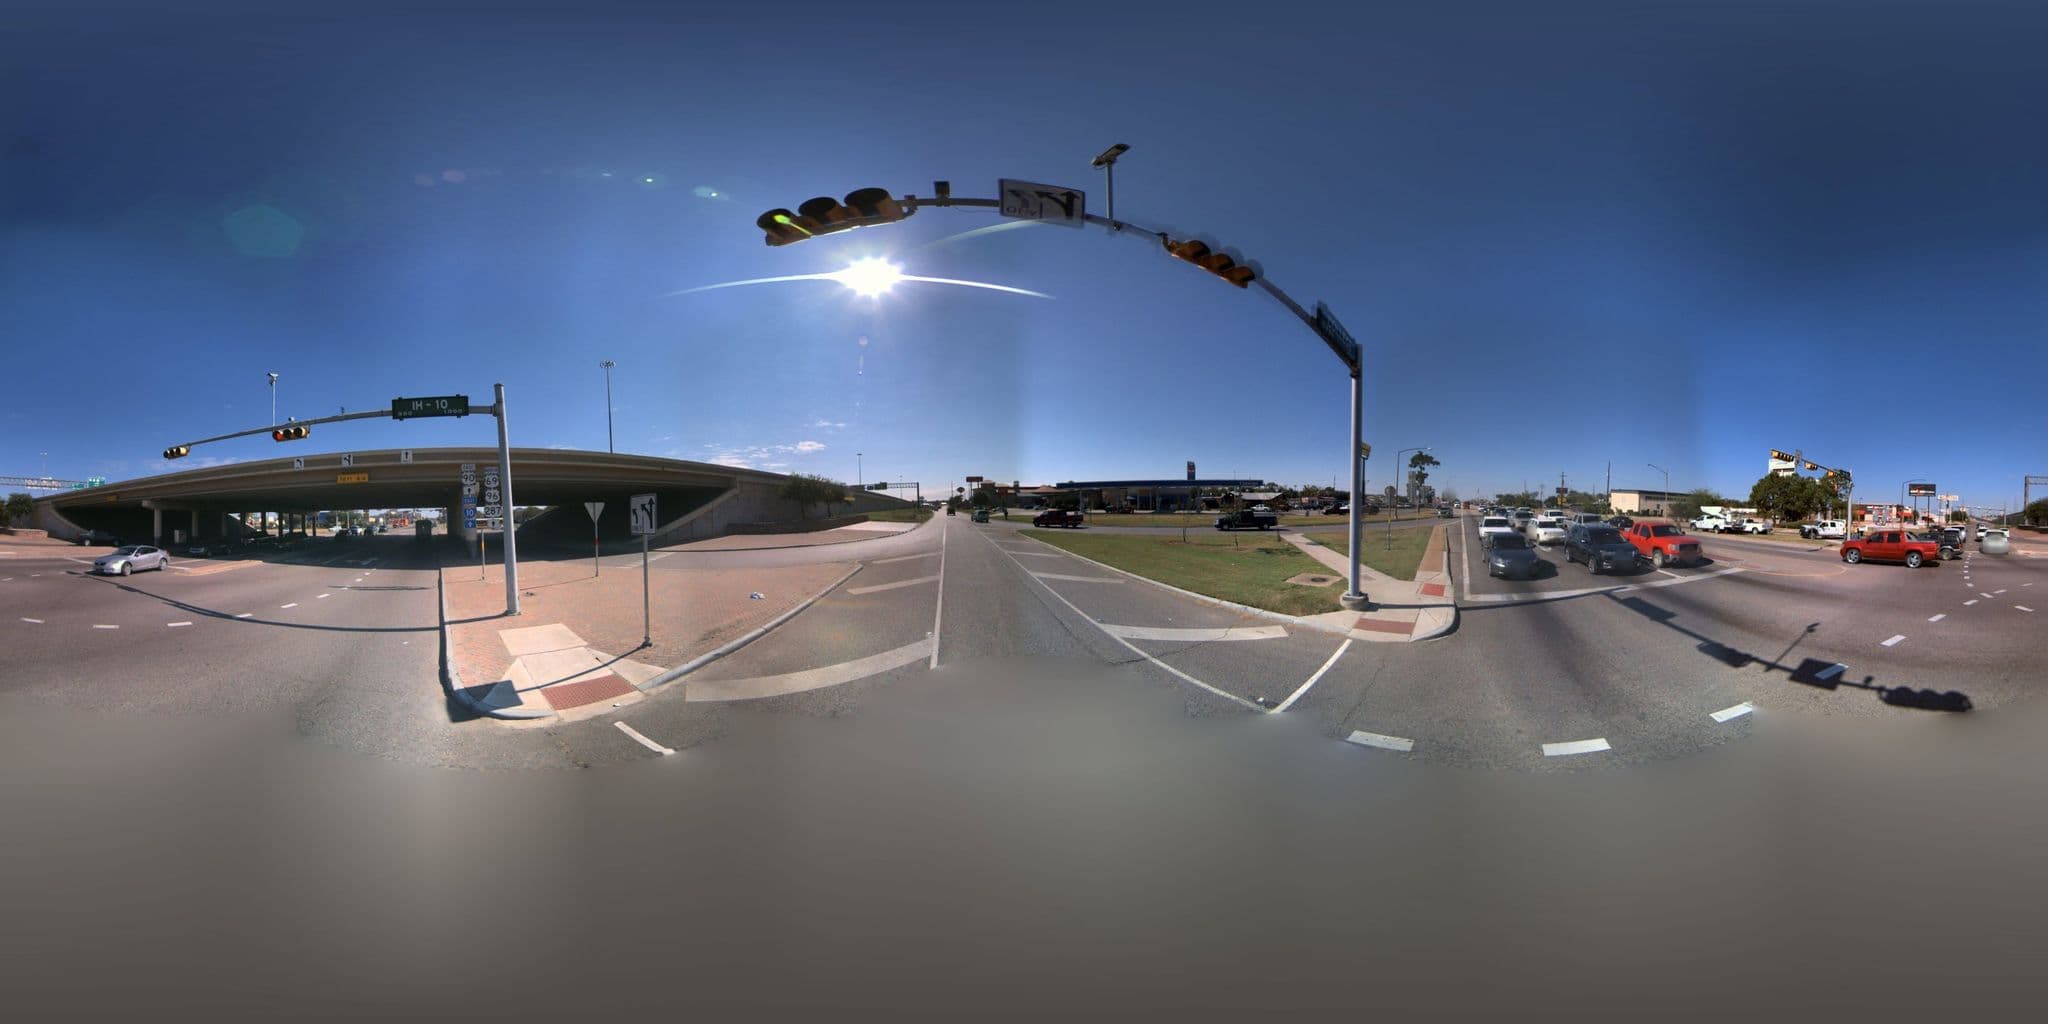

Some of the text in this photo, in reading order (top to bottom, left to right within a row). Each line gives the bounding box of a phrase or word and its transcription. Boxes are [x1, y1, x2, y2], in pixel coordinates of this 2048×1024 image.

[463, 474, 475, 482] 90
[486, 477, 497, 485] 69
[486, 492, 498, 500] 96
[465, 509, 474, 517] 10
[484, 507, 502, 515] 287
